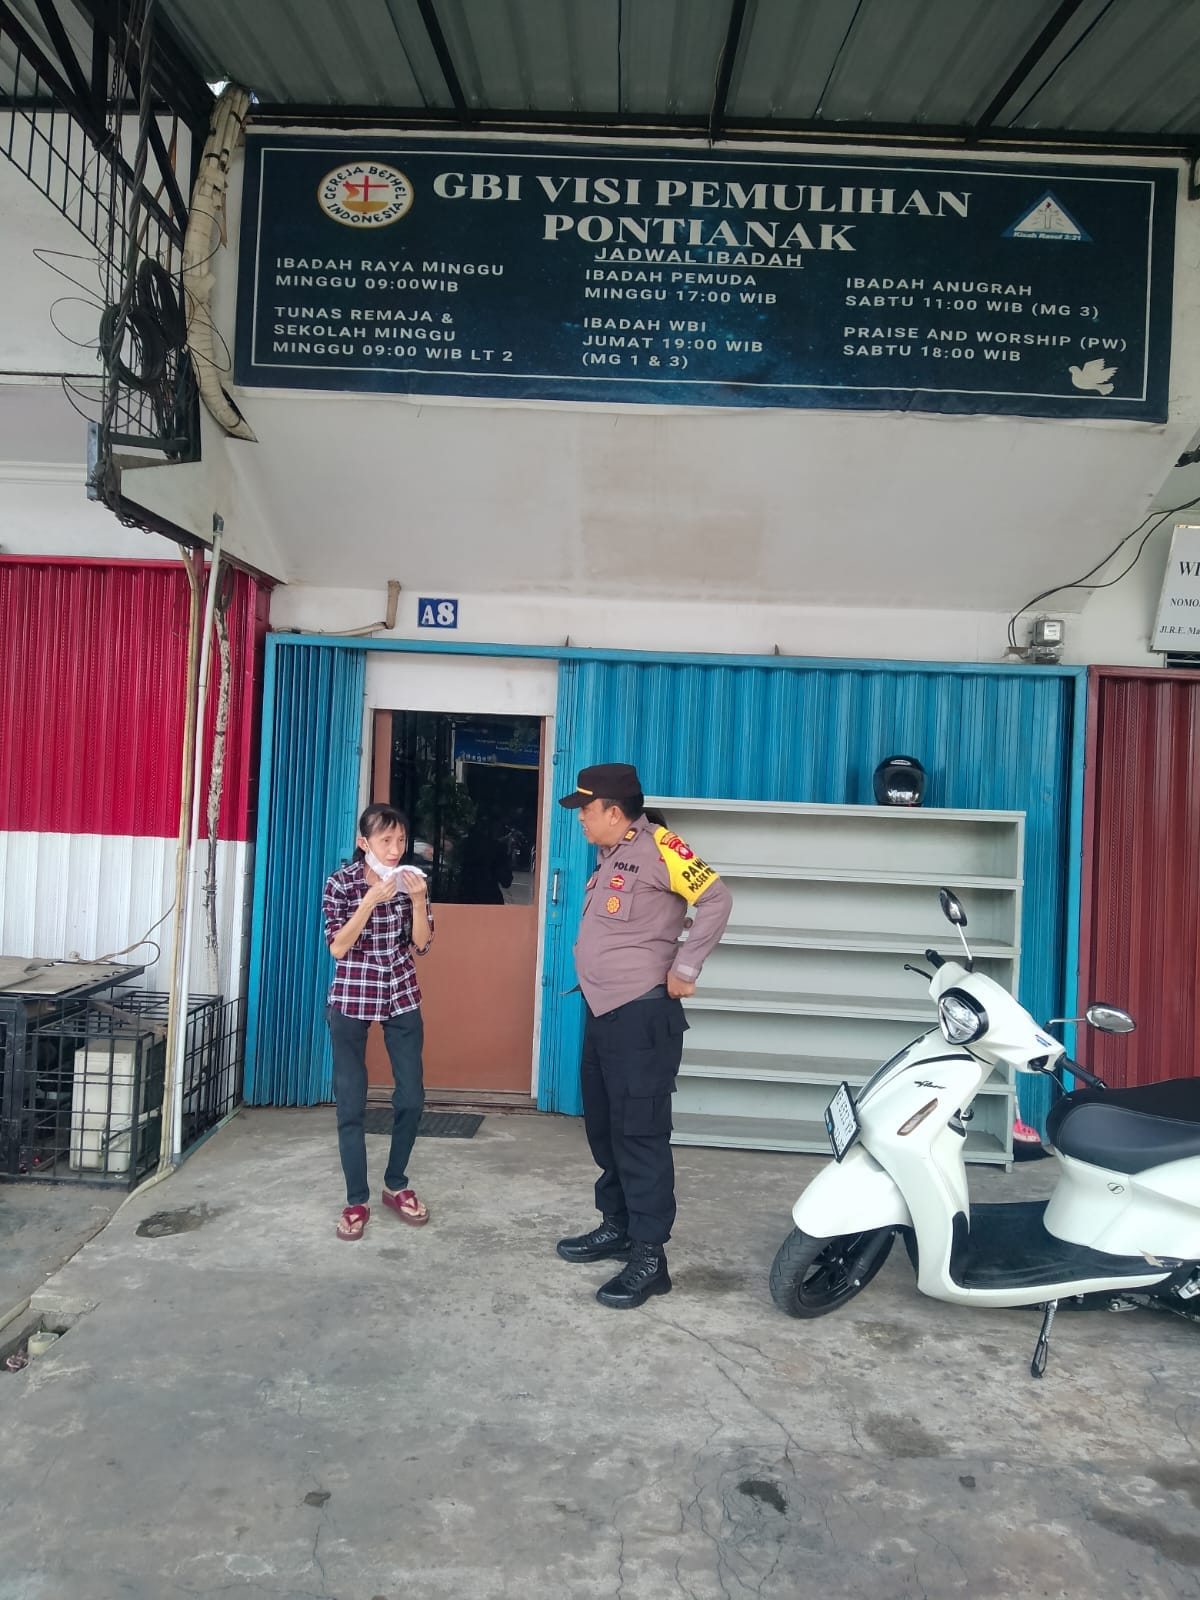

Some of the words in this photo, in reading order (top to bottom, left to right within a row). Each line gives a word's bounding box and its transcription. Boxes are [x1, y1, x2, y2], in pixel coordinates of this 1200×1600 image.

[324, 166, 364, 200] GEREJA
[368, 166, 407, 200] BETHEL
[433, 172, 523, 201] GBI
[535, 175, 642, 206] VISI
[656, 179, 973, 218] PEMULIHAN
[327, 202, 404, 223] INDONESIA
[542, 214, 857, 251] PONTIANAK
[594, 247, 697, 263] JADWAL
[707, 251, 802, 267] IBADAH
[276, 257, 352, 270] IBADAH
[361, 260, 414, 272] RAYA
[422, 262, 504, 276] MINGGU
[275, 275, 357, 289] MINGGU
[585, 269, 663, 283] IBADAH
[671, 272, 757, 286] PEMUDA
[846, 277, 924, 290] IBADAH
[932, 281, 1033, 296] ANUGRAH
[584, 287, 667, 301] MINGGU
[676, 290, 731, 303] 17:00
[739, 292, 777, 304] WIB
[274, 306, 342, 319] TUNAS
[350, 309, 433, 323] REMAJA
[441, 313, 453, 324] &
[845, 295, 914, 307] SABTU
[923, 297, 978, 311] 11:00
[986, 300, 1023, 313] WIB
[1031, 302, 1071, 317] (MG
[1080, 306, 1099, 320] 3)
[273, 324, 366, 338] SEKOLAH
[374, 327, 456, 342] MINGGU
[583, 317, 661, 331] IBADAH
[669, 320, 706, 332] WBI
[582, 335, 653, 349] JUMAT
[662, 338, 717, 350] 19:00
[726, 340, 764, 352] WIB
[844, 326, 919, 339] PRAISE
[927, 328, 968, 342] AND
[976, 331, 1072, 346] WORSHIP
[1080, 336, 1127, 352] (PW)
[272, 341, 354, 356] MINGGU
[362, 345, 417, 357] 09:00
[426, 347, 462, 360] WIB
[471, 350, 494, 361] LT
[502, 351, 513, 362] 2
[582, 352, 621, 366] (MG
[630, 355, 638, 366] 1
[648, 355, 661, 366] &
[669, 355, 689, 369] 3)
[843, 345, 912, 357] SABTU
[920, 346, 975, 359] 18:00
[984, 349, 1021, 362] WIB
[1171, 598, 1200, 607] NOMO
[421, 602, 455, 625] A8
[613, 861, 639, 874] POLRI
